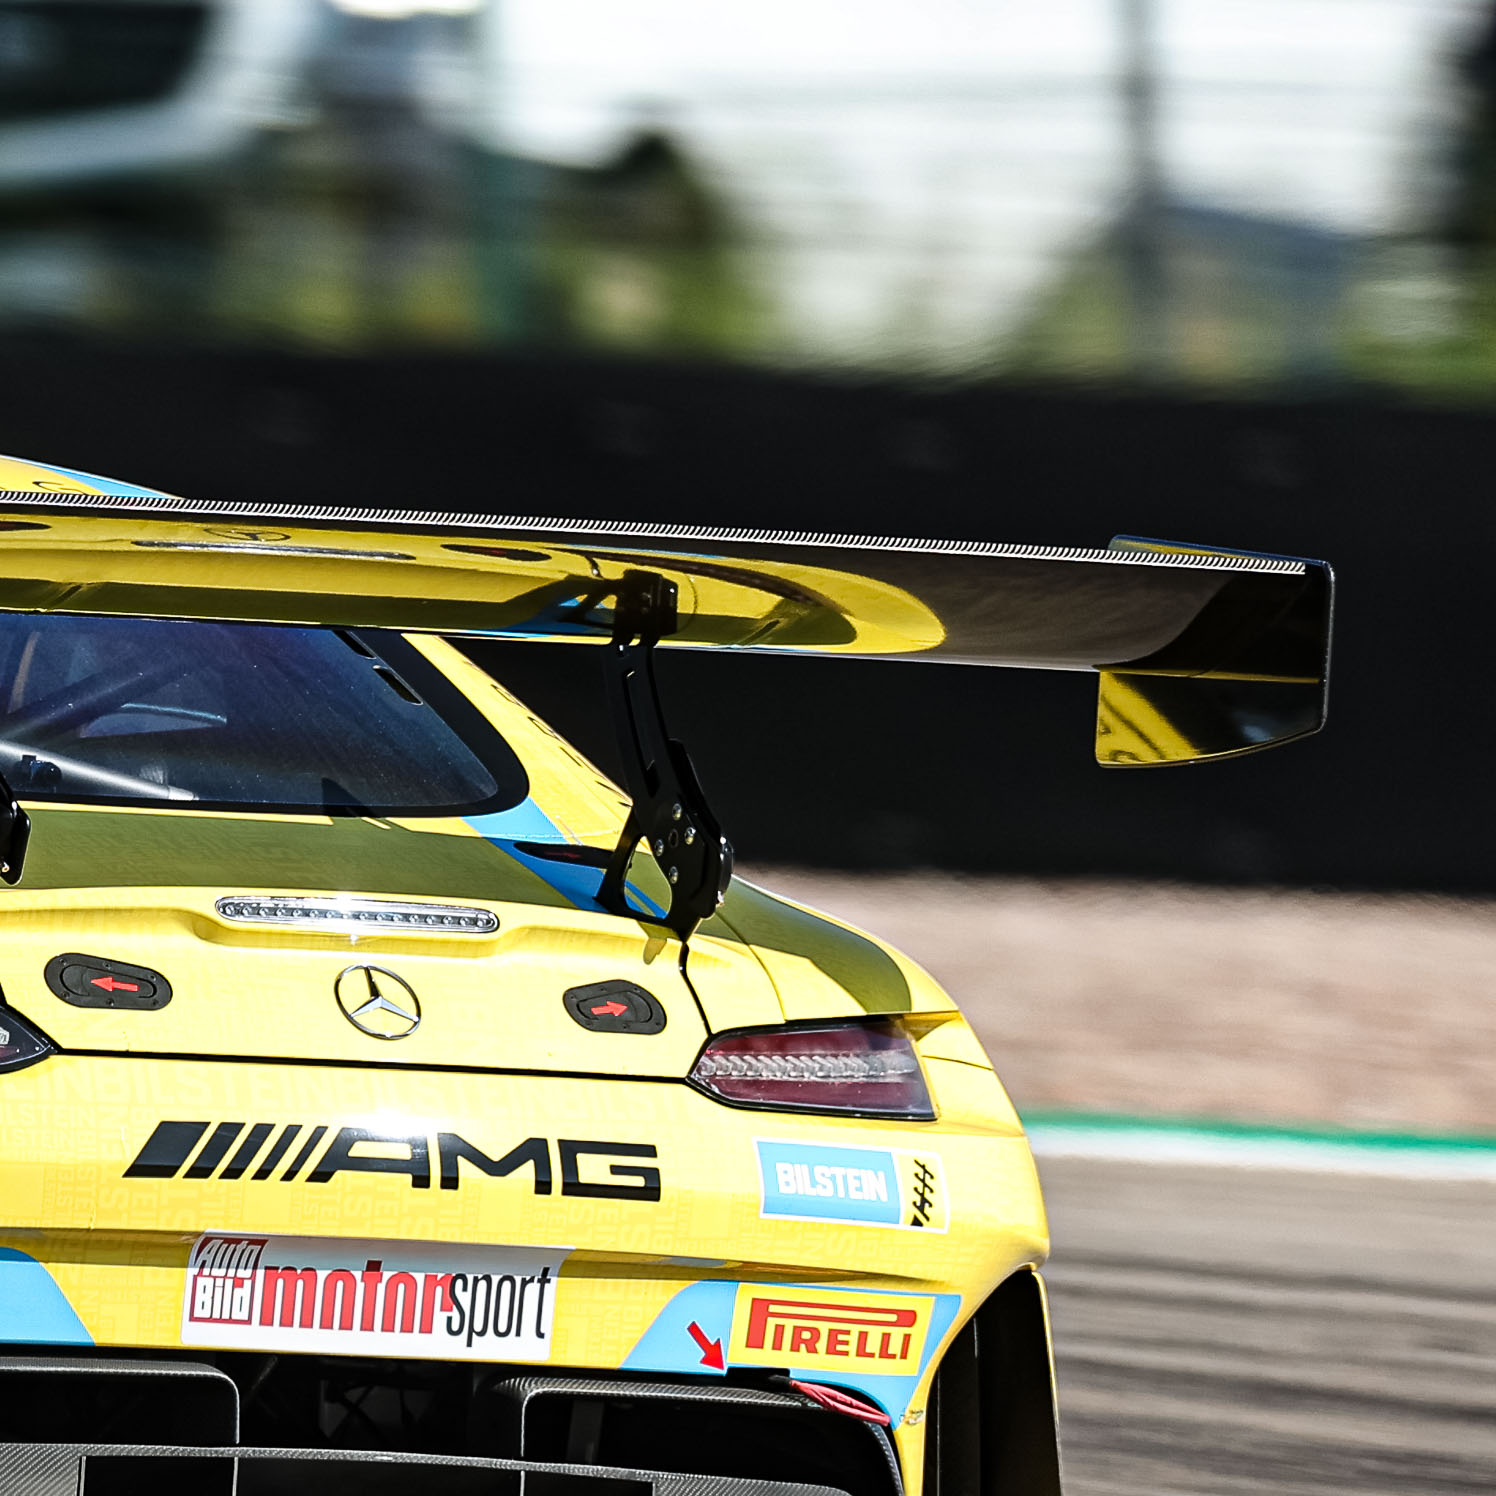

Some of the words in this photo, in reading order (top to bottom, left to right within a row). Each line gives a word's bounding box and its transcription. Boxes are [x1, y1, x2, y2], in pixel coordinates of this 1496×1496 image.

[305, 1127, 660, 1201] AMG
[775, 1162, 888, 1202] BILSTEIN
[194, 1239, 261, 1276] Auto
[193, 1276, 250, 1319] Bild
[745, 1297, 917, 1360] PIRELLI
